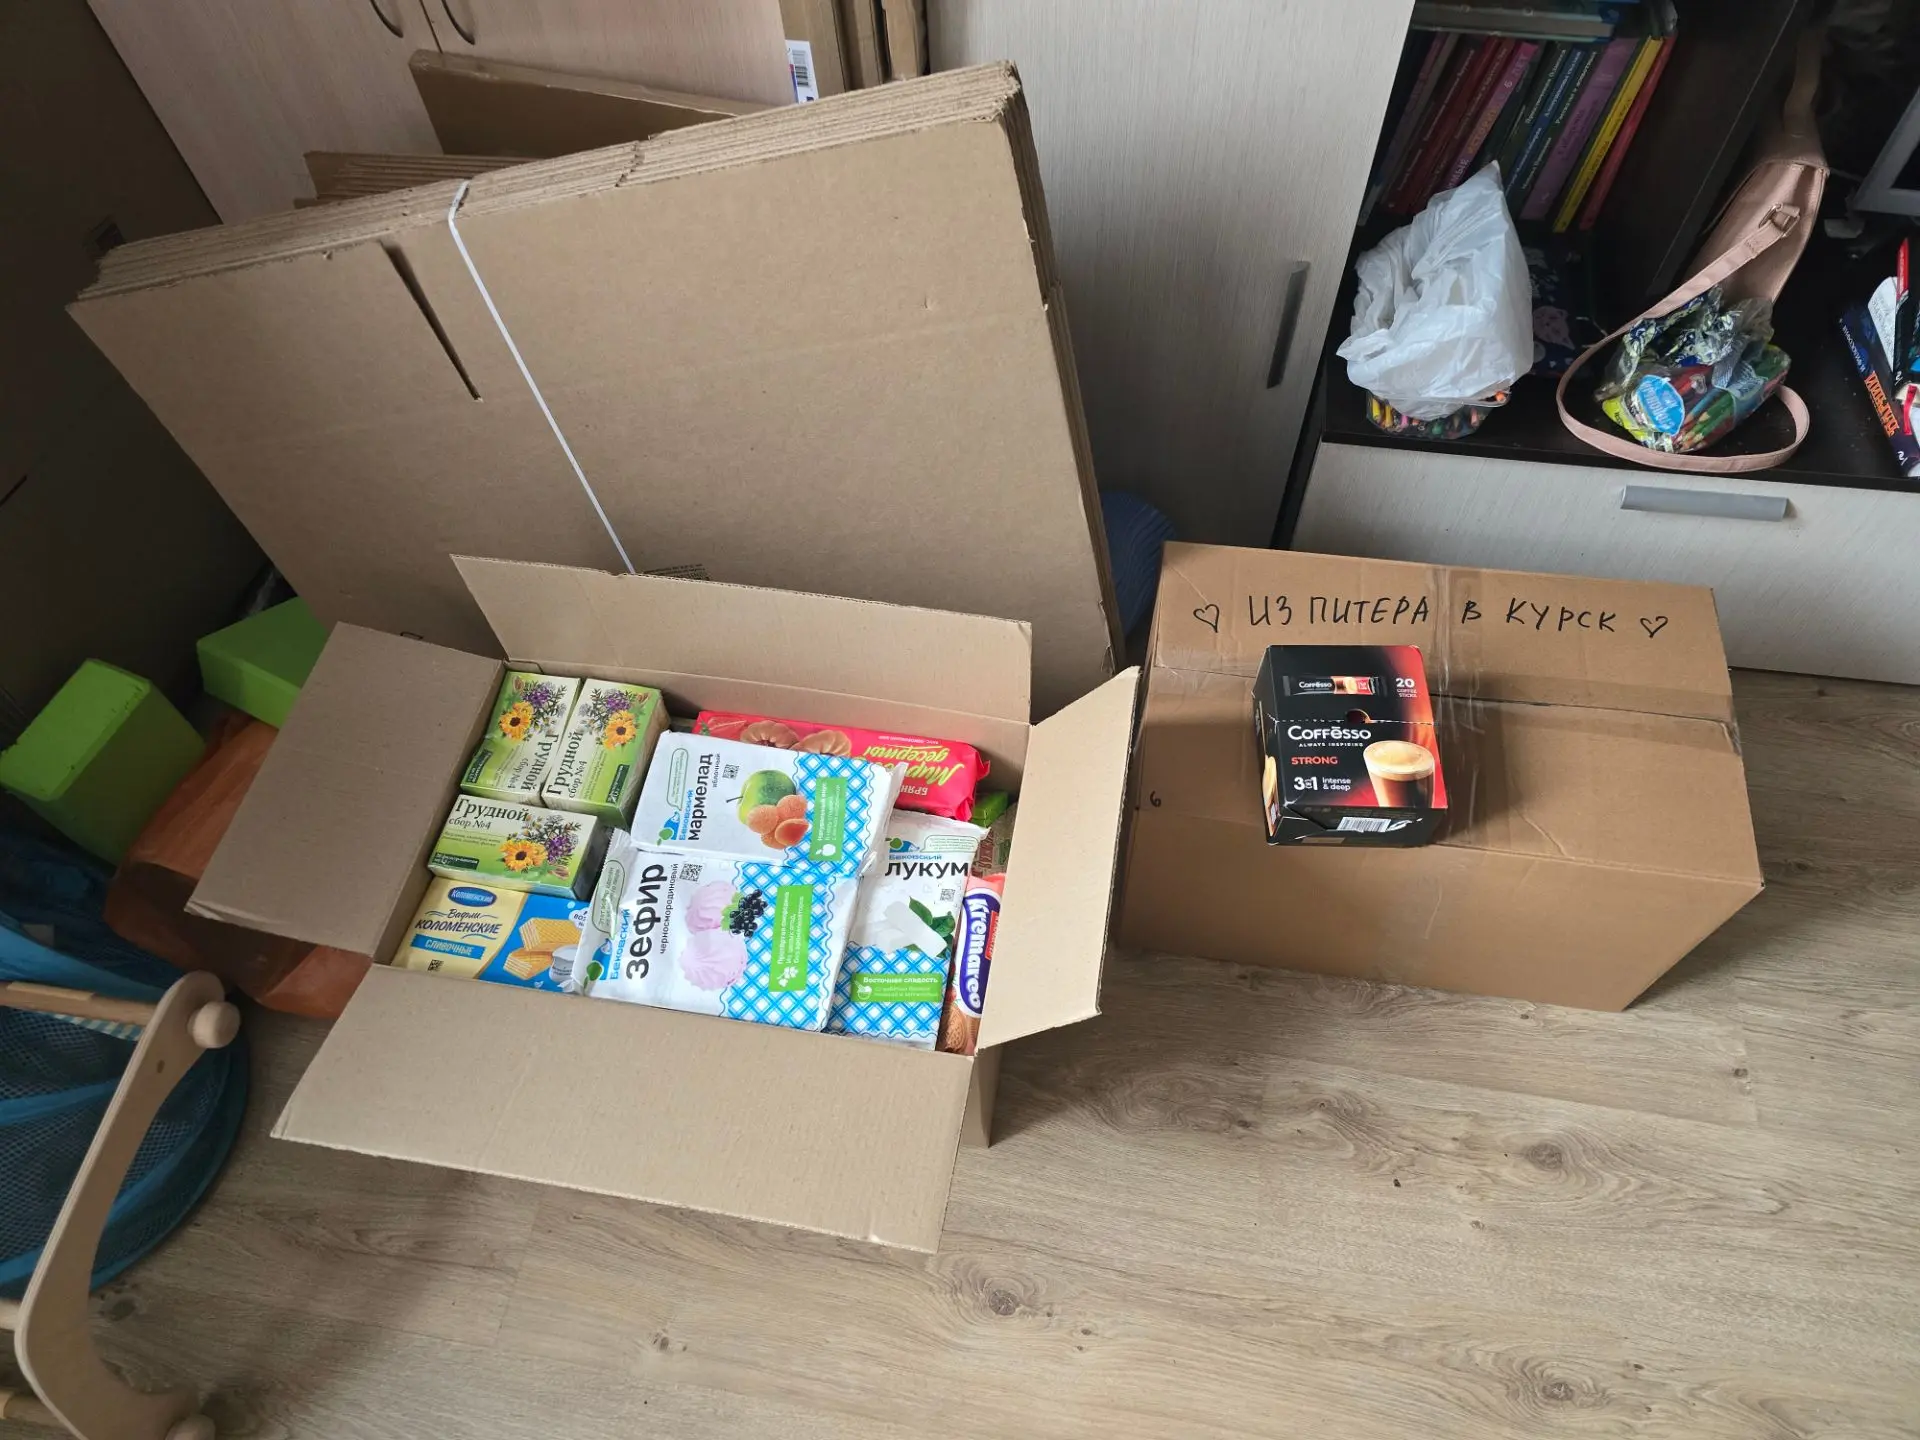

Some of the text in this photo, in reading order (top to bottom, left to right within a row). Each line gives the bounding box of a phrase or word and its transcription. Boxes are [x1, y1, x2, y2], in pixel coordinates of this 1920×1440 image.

[1249, 595, 1292, 626] ИЗ
[1310, 595, 1429, 625] ПИТЕРА
[1506, 597, 1617, 632] КУРСК
[1395, 677, 1415, 688] 20
[520, 735, 560, 791] Грудной
[546, 729, 583, 795] Грудной
[1291, 756, 1338, 765] STRONG
[455, 798, 529, 822] Грудной
[688, 754, 714, 840] мармелад
[448, 815, 472, 828] сбор
[626, 864, 668, 979] зефир
[660, 863, 679, 954] черносмородиновый
[414, 919, 502, 934] КОЛОМЕНСКИЕ
[425, 938, 475, 956] СЛИВОЧНЫЕ
